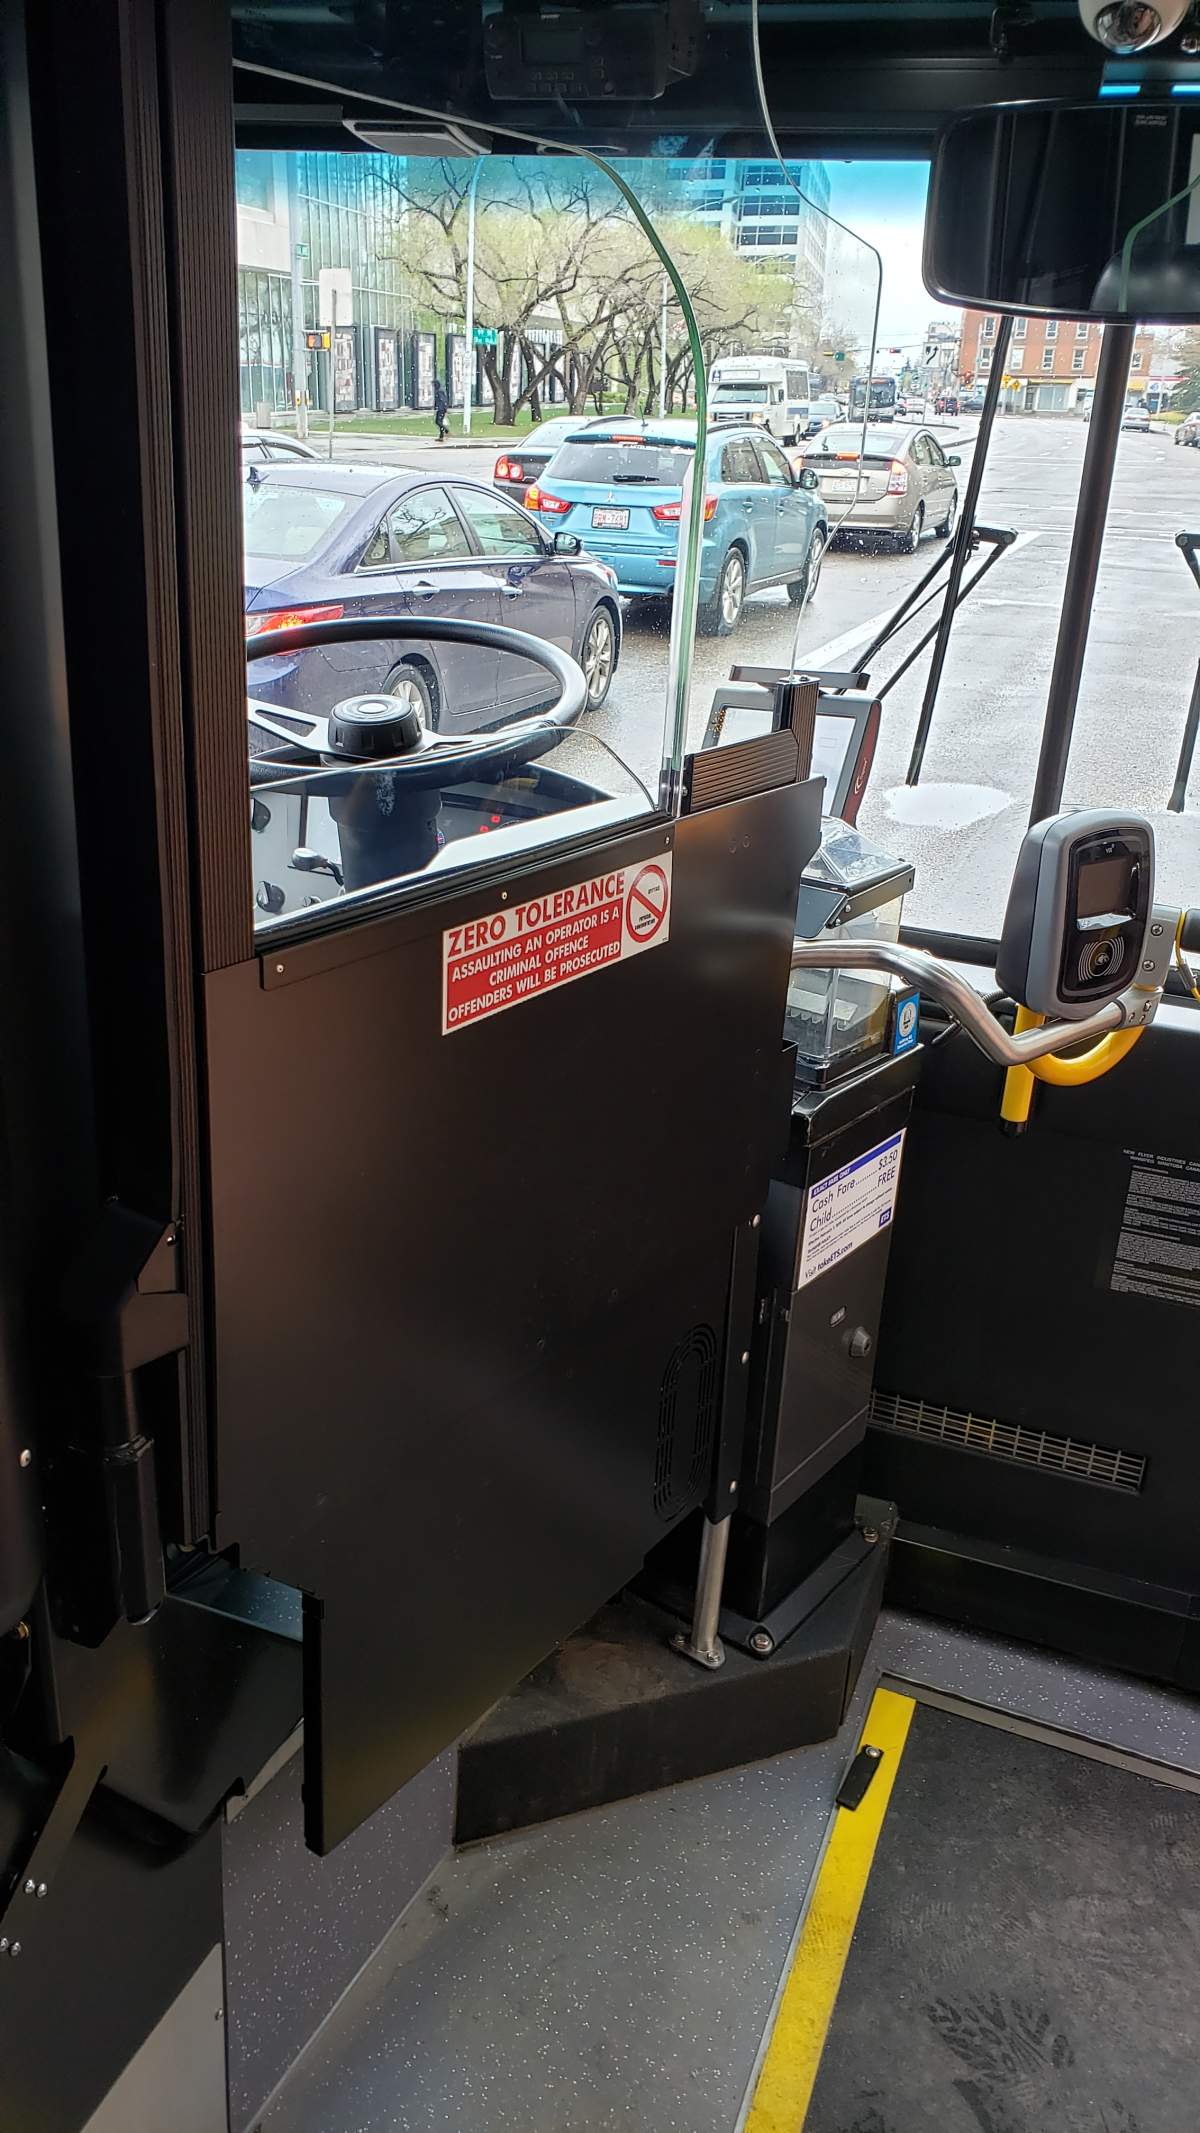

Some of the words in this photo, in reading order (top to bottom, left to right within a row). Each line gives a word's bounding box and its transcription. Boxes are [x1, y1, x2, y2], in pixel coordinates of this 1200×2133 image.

[448, 916, 506, 958] ZERO
[515, 871, 625, 931] TOLERANCE
[452, 944, 521, 982] ASSAULTING
[525, 936, 542, 954] AN
[546, 916, 598, 944] OPERATOR
[600, 912, 610, 924] IS
[611, 906, 619, 920] A
[448, 984, 512, 1022] OFFENDERS
[516, 973, 541, 994] WILL
[544, 969, 557, 983] BE
[560, 942, 620, 976] PROSECUTED
[489, 958, 542, 986] CRIMINAL
[545, 936, 588, 964] OFFENCE
[810, 1208, 832, 1232] Child
[878, 1166, 896, 1188] FREE
[812, 1191, 833, 1213] Cash
[838, 1179, 855, 1198] Fare
[878, 1149, 898, 1171] $3.50
[817, 1242, 853, 1271] takeETS.com
